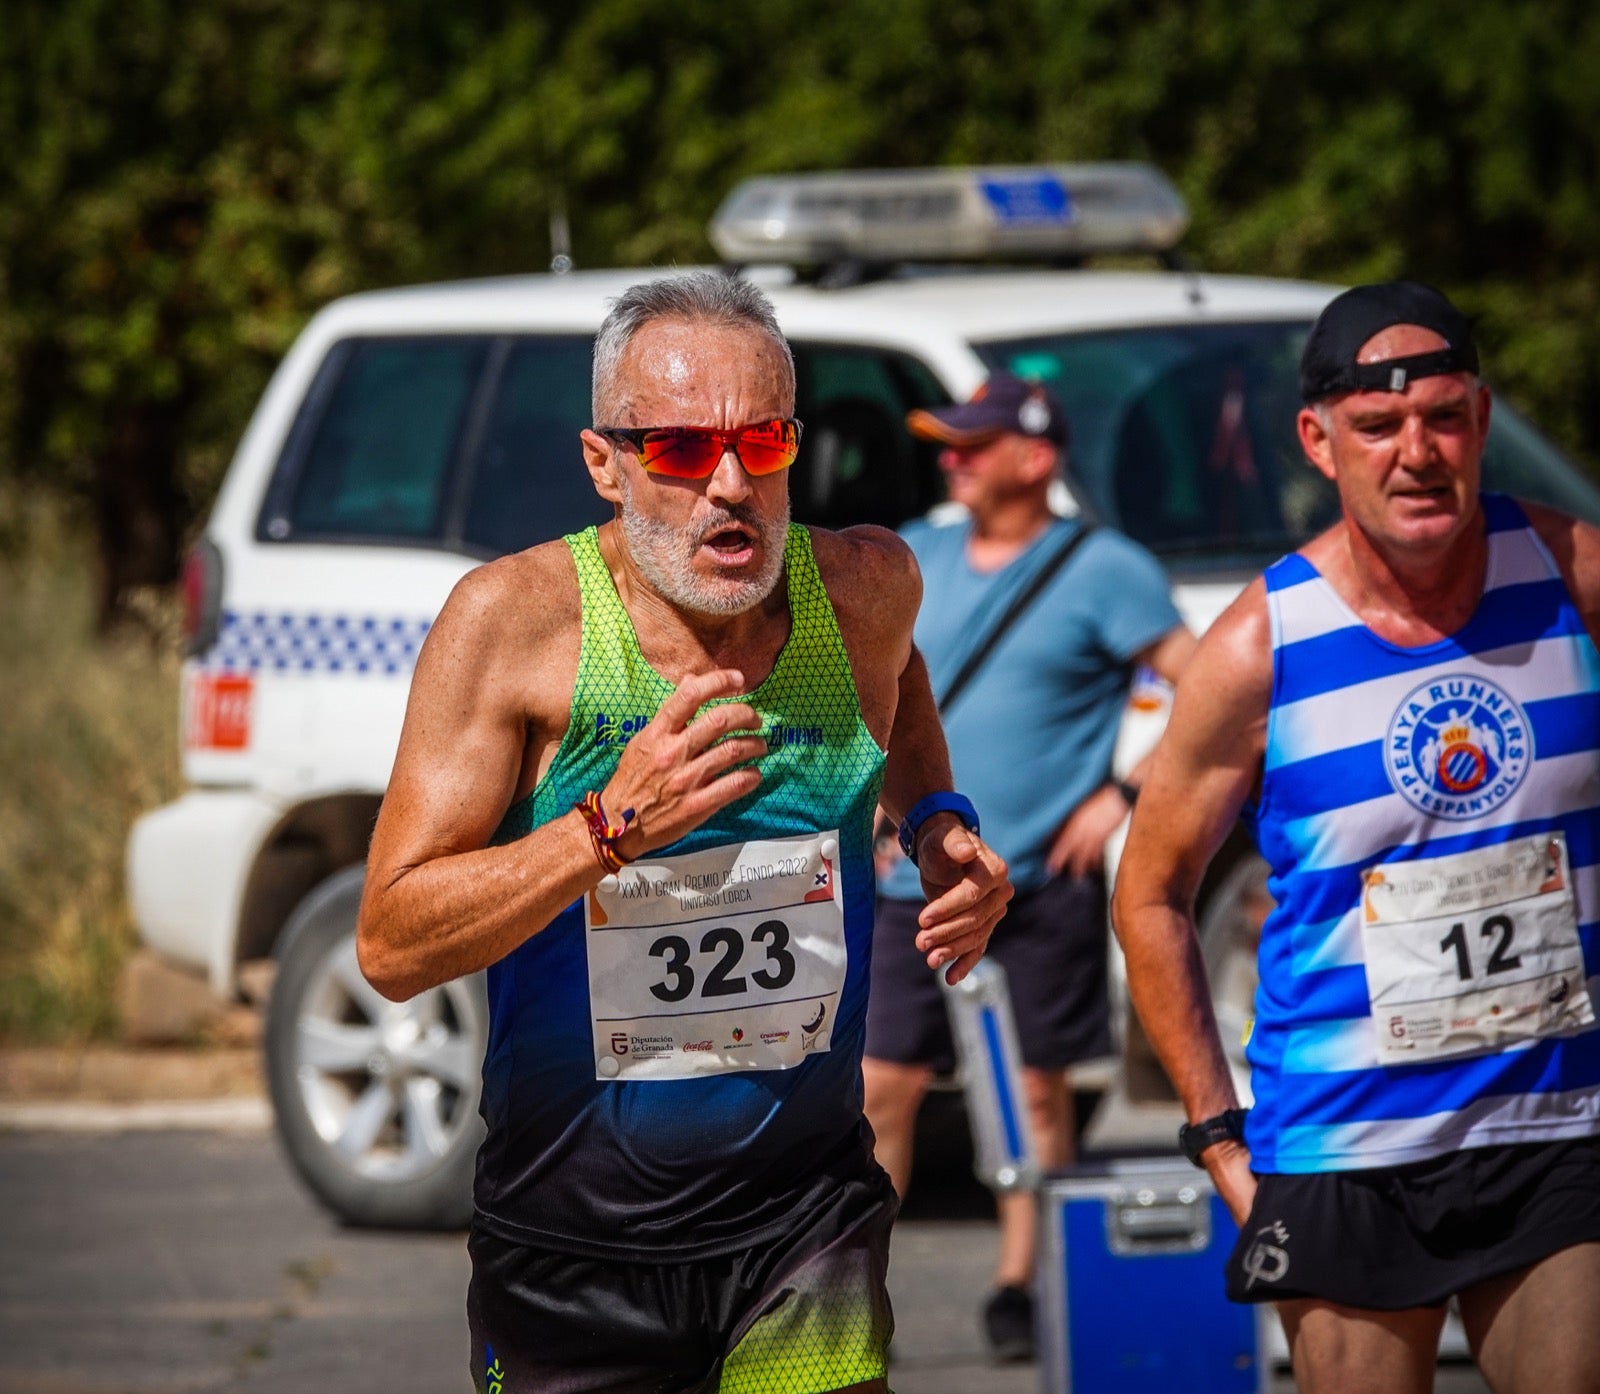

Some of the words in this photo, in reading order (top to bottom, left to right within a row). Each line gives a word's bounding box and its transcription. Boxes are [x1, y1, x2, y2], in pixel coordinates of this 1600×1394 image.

[1393, 702, 1425, 787] PENYA
[1429, 681, 1524, 759] RUNNERS
[1420, 776, 1516, 814] ESPANYOL
[655, 879, 681, 897] GRAN
[684, 872, 720, 891] PREMIO
[723, 869, 736, 885] DE
[740, 864, 775, 882] FONDO
[778, 857, 808, 877] 2022
[680, 893, 720, 912] UNIVERSO
[723, 888, 752, 905] LORCA
[648, 920, 796, 1002] 323
[1440, 914, 1523, 982] 12
[630, 1035, 673, 1045] Diputación
[631, 1045, 641, 1053] de
[641, 1044, 674, 1052] Granada
